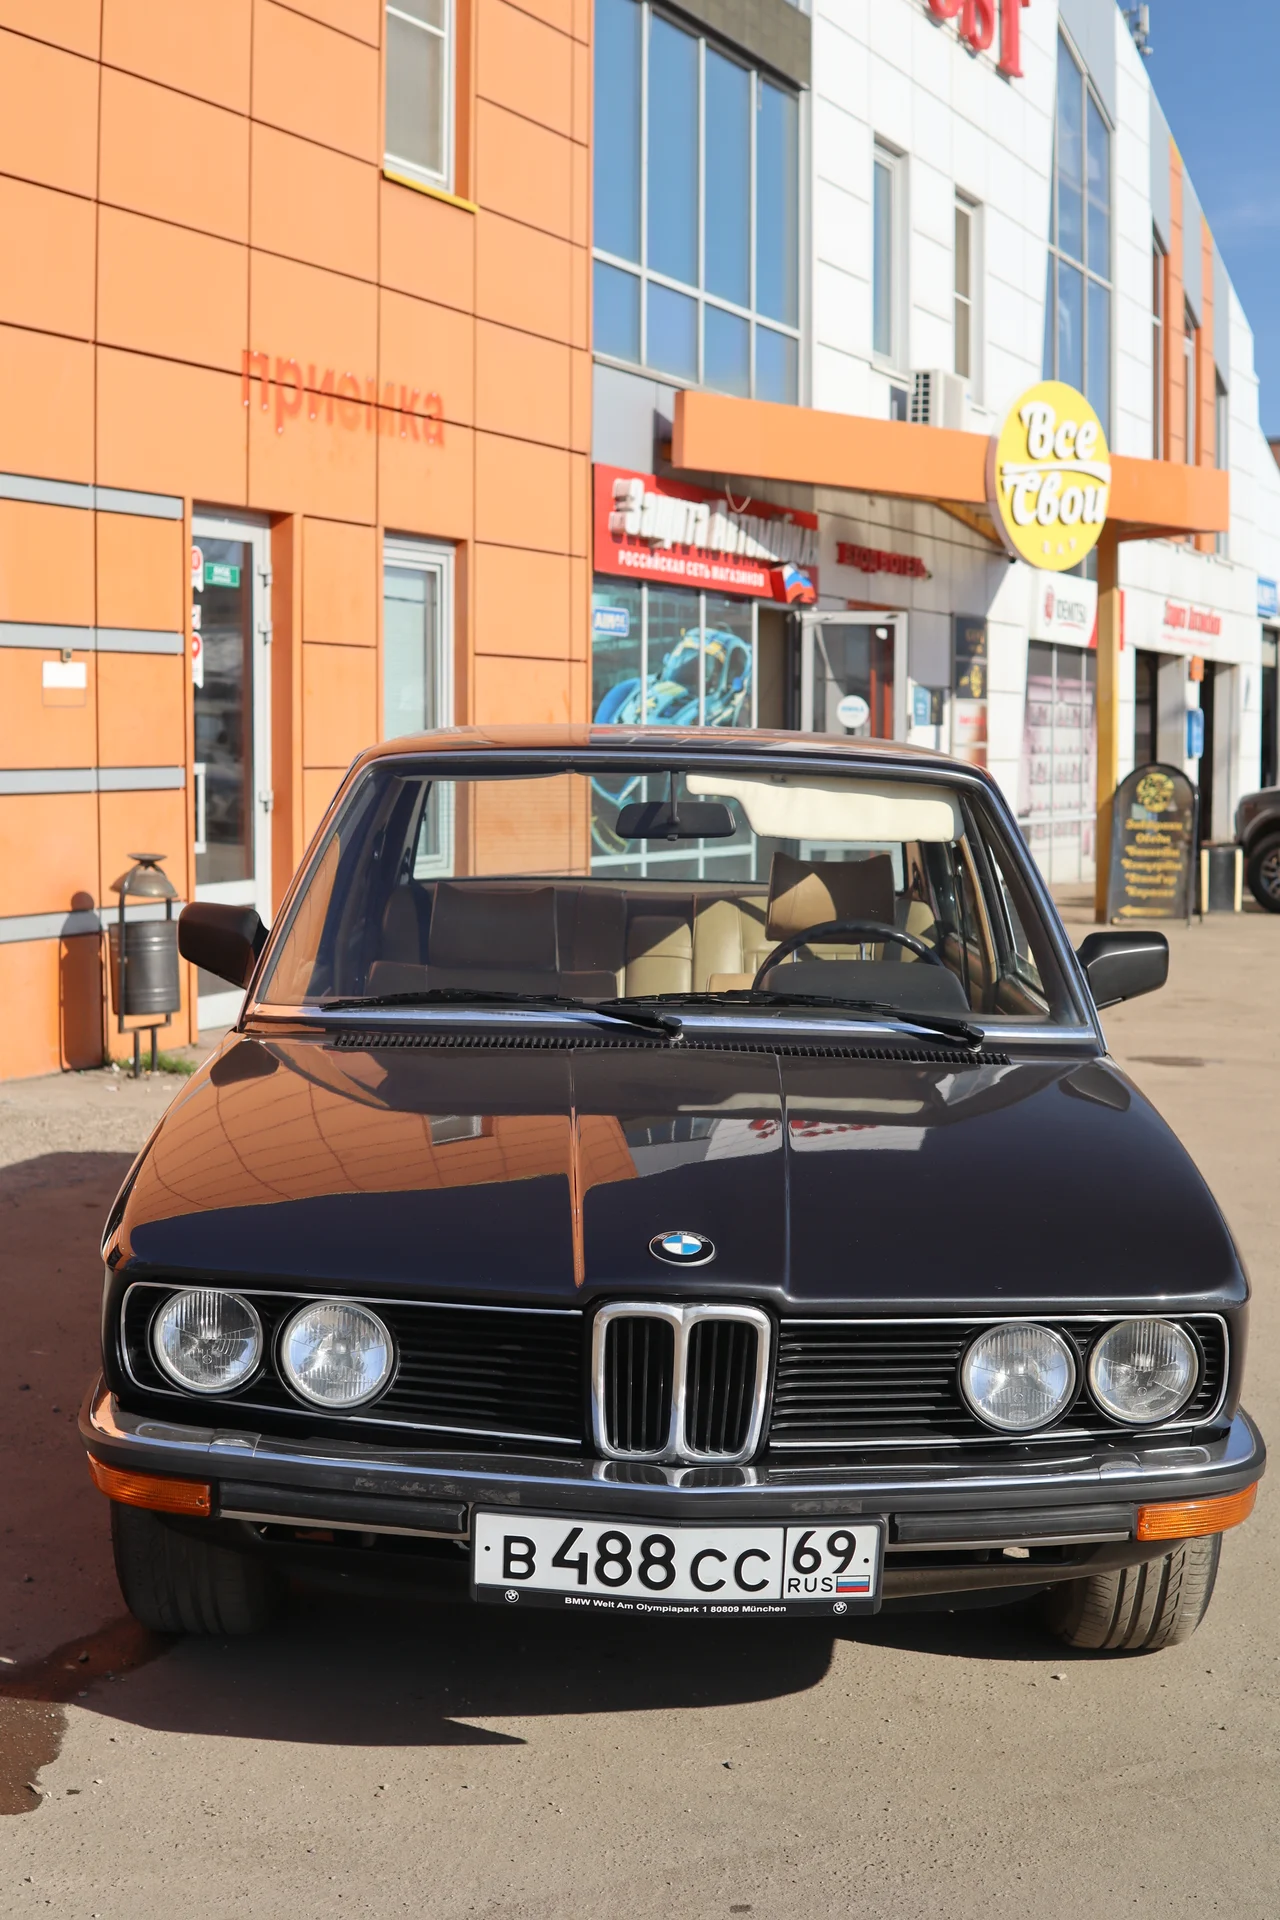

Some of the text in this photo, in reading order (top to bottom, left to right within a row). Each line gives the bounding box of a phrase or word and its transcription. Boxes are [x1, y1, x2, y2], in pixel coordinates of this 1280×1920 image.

[241, 349, 444, 449] приемка
[1018, 401, 1098, 460] Все
[1001, 471, 1108, 526] Свои
[618, 549, 765, 588] РОССИЙСКАЯ СЕТЬ МАГАЗИНОВ
[552, 1527, 676, 1591] 488
[793, 1530, 857, 1575] 69
[564, 1597, 591, 1606] BMW
[593, 1600, 615, 1608] Welt
[617, 1602, 634, 1610] Am
[636, 1603, 699, 1613] Olympiapark
[710, 1605, 740, 1613] 80809
[742, 1605, 787, 1613] München
[787, 1577, 833, 1593] RUS
